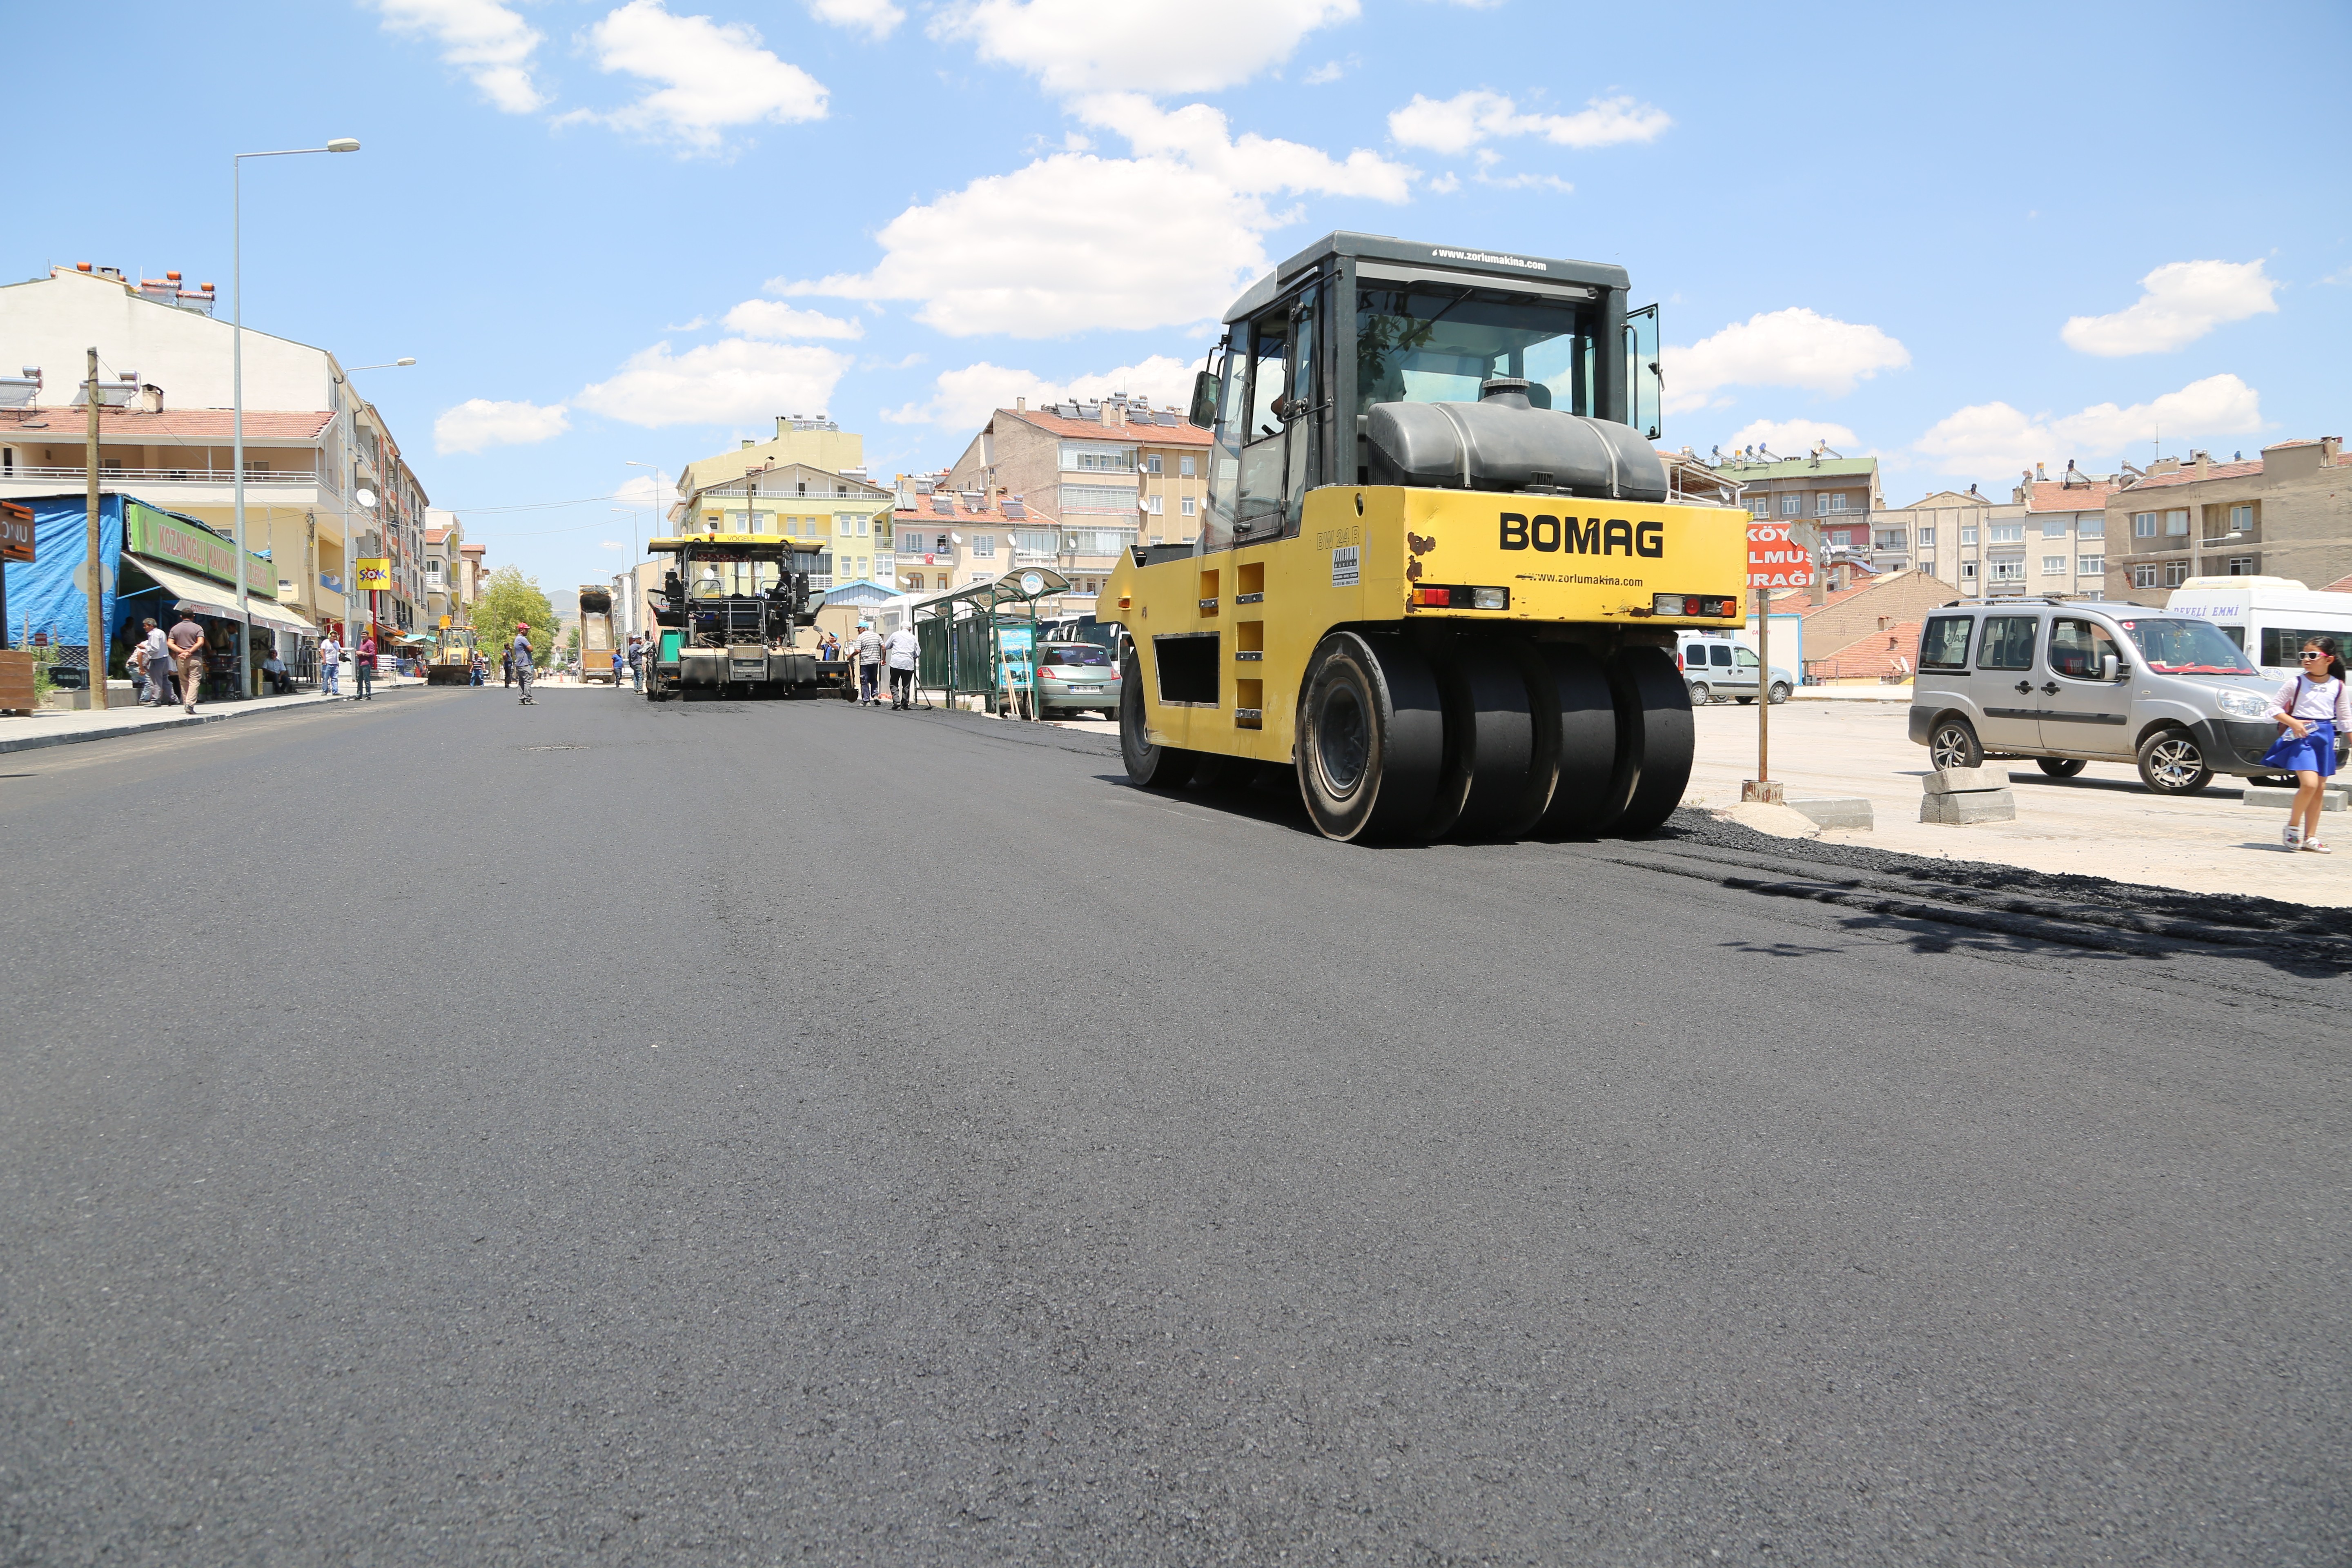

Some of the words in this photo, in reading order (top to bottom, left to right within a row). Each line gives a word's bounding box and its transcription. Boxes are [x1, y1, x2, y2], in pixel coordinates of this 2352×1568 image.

[1439, 249, 1547, 271] www.zorlumakina.com
[1317, 530, 1334, 550] BW
[1336, 528, 1350, 547] 24
[1352, 526, 1360, 545] R
[1500, 512, 1663, 558] BOMAG
[158, 523, 206, 566] KOZANOĞLU
[208, 542, 229, 576] KAVUN
[1334, 547, 1357, 562] ZORLU
[1749, 551, 1813, 566] LMUŞ
[1528, 573, 1643, 587] www.zorlumakina.com
[1746, 570, 1814, 586] RAĞI
[2212, 604, 2239, 616] EMMİ
